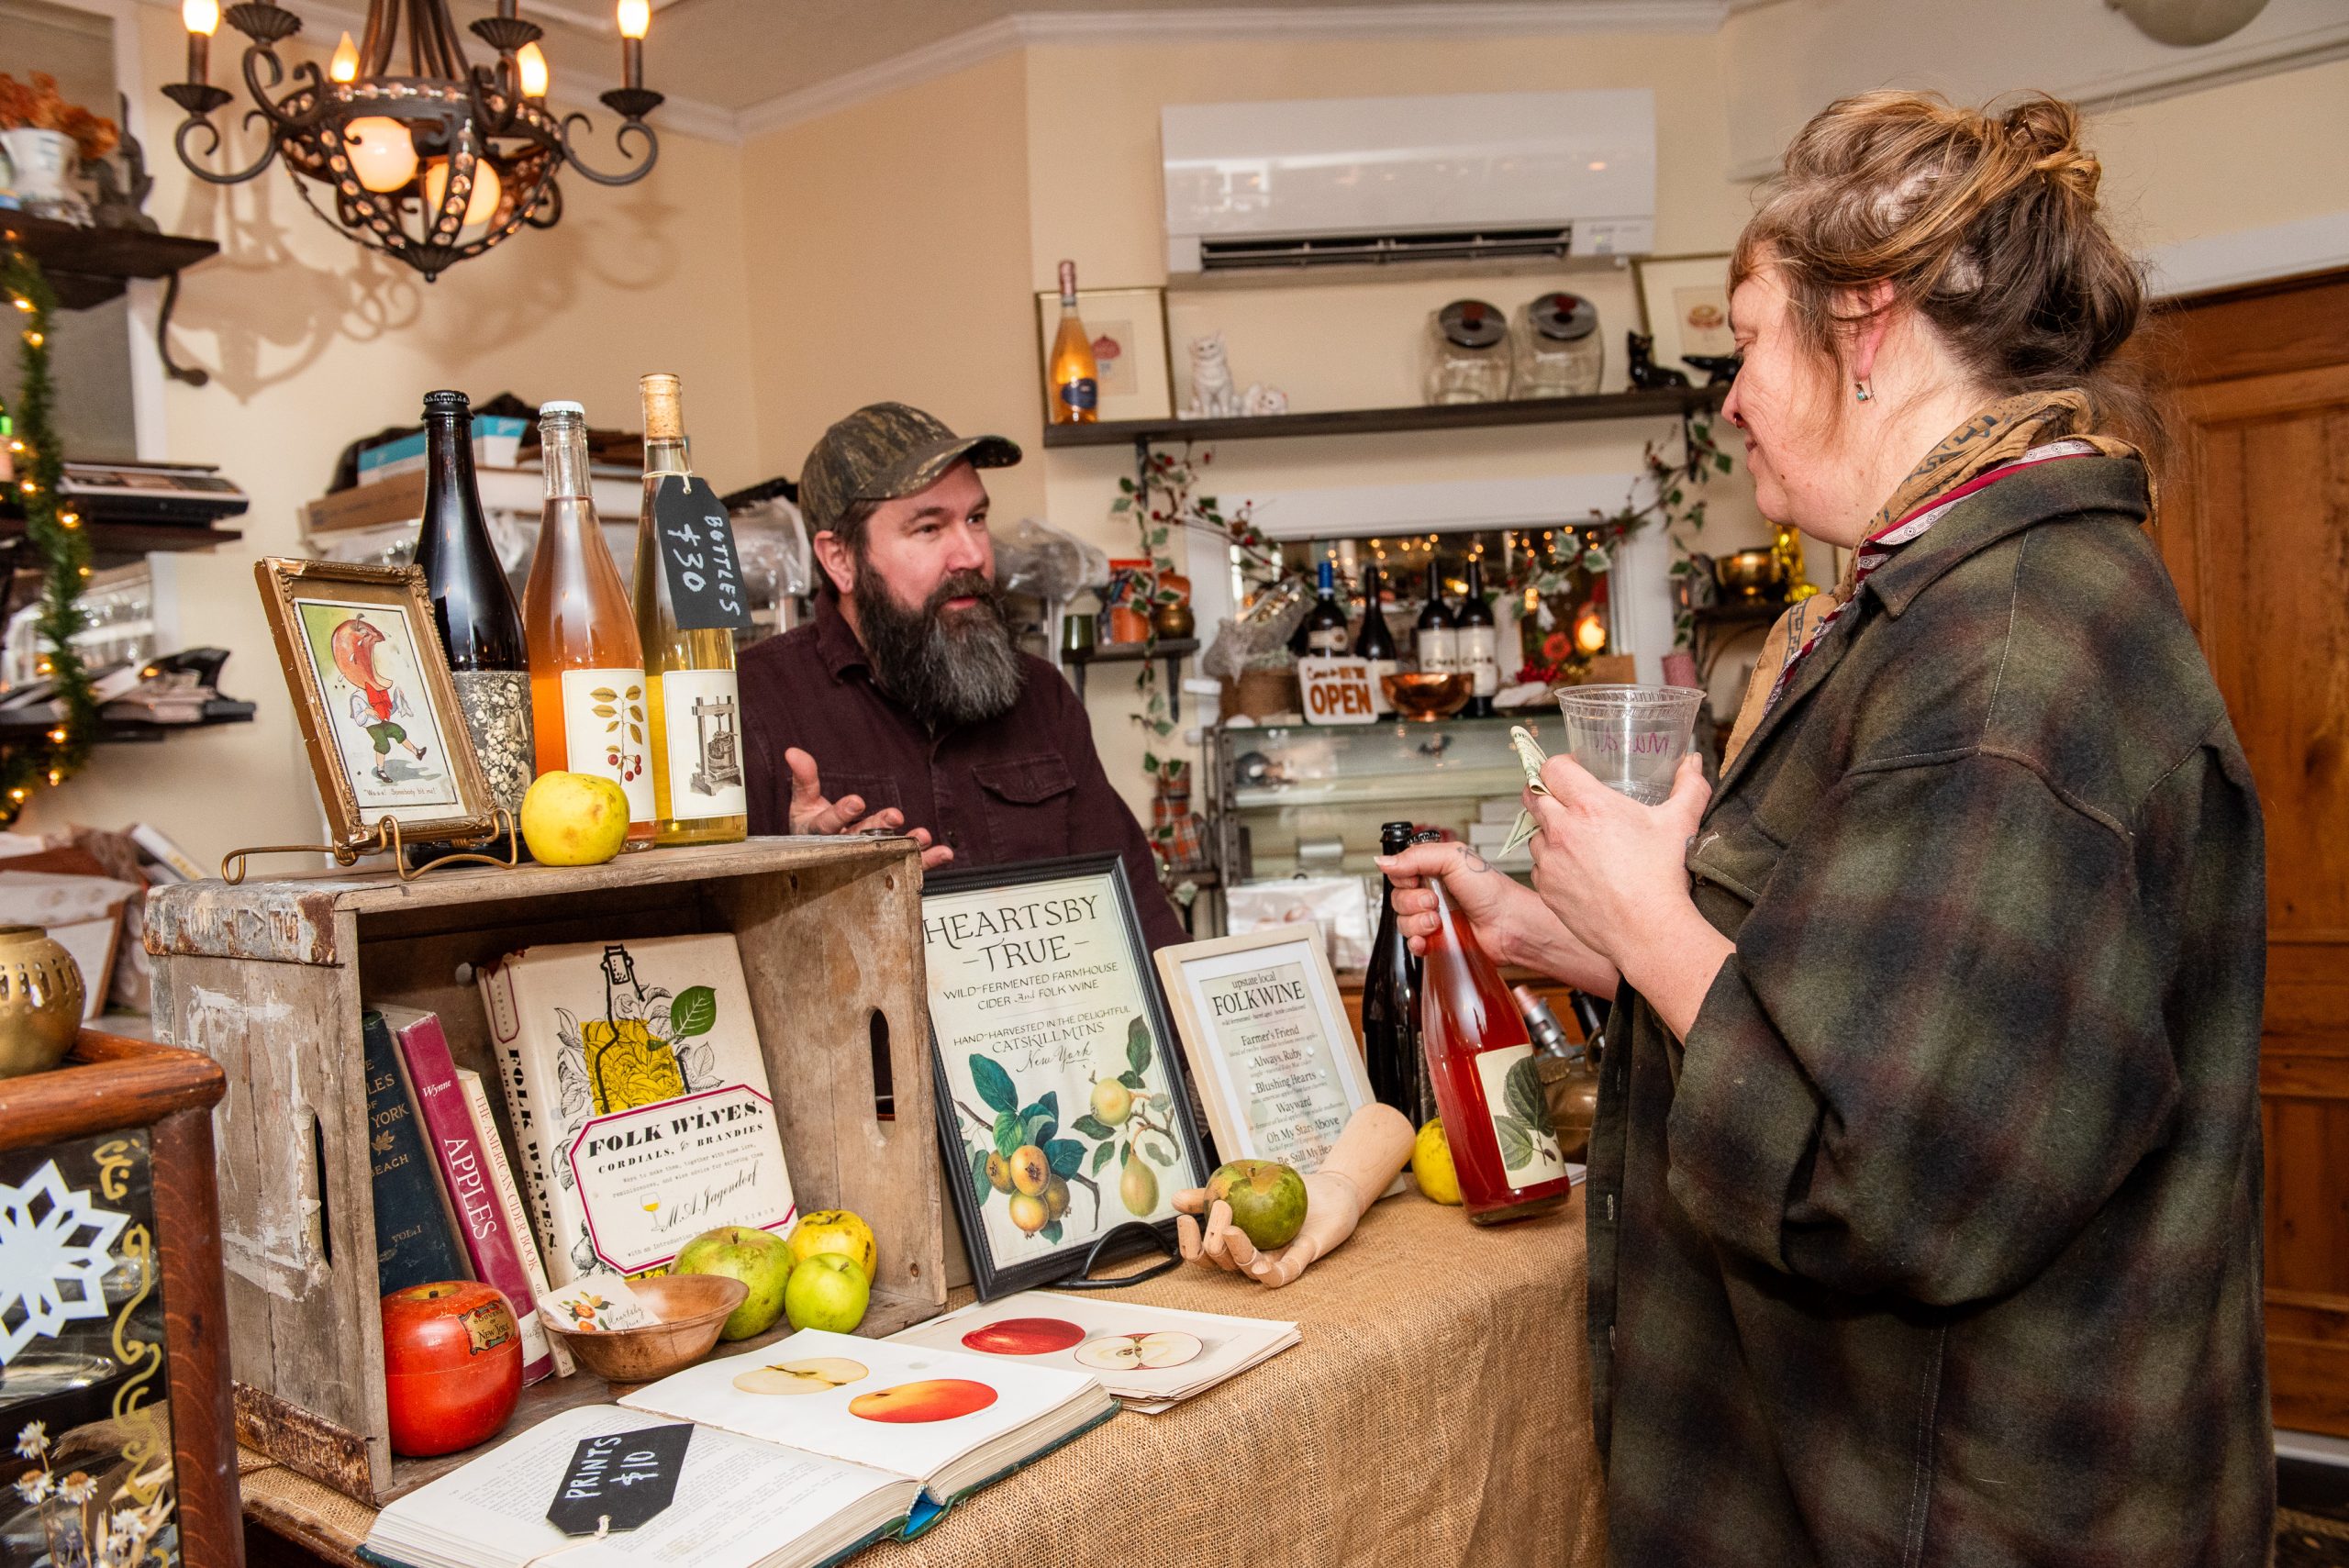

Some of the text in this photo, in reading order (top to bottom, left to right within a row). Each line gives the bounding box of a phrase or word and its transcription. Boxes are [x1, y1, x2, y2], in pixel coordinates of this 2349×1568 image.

[668, 524, 707, 592] $30
[704, 516, 740, 616] BOTTLES
[1310, 684, 1373, 716] OPEN
[923, 895, 1097, 950] HEARTSBY
[978, 935, 1071, 973] TRUE
[943, 962, 1119, 1000] WILD-FERMENTED FARMHOUSE
[977, 995, 1011, 1011] CIDER
[1039, 986, 1067, 999] FOLK
[1070, 979, 1099, 993] WINE
[1231, 971, 1277, 991] upstate local
[953, 1006, 1130, 1046] HAND-HARVESTED IN THE DELIGHTFUL
[992, 1021, 1105, 1054] CATSKILL MTNS
[1241, 1030, 1275, 1047] Farmer's
[1275, 1024, 1300, 1040] Friend
[1016, 1040, 1093, 1073] New York
[1283, 1048, 1302, 1062] Ruby
[366, 1073, 395, 1095] LES
[422, 1079, 451, 1098] Wynne
[507, 1047, 534, 1130] FOLK
[1255, 1076, 1292, 1094] Blushing
[1291, 1071, 1317, 1085] Hearts
[371, 1103, 409, 1129] YORK
[1275, 1095, 1312, 1114] Wayward
[586, 1124, 663, 1159] FOLK
[680, 1140, 690, 1151] &
[697, 1123, 764, 1147] BRANDIES
[1266, 1131, 1281, 1145] Oh
[1281, 1128, 1295, 1140] My
[1295, 1123, 1314, 1137] Stars
[1315, 1117, 1341, 1131] Above
[684, 1155, 709, 1166] together
[711, 1151, 724, 1160] with
[1290, 1149, 1308, 1163] Still
[1307, 1147, 1320, 1160] My
[1319, 1144, 1332, 1156] Hea
[444, 1138, 497, 1240] APPLES
[475, 1092, 540, 1272] THE AMERICAN CIDER BOOK
[628, 1248, 642, 1257] with
[653, 1231, 696, 1250] Introduction
[564, 1437, 622, 1498] PRINTS
[608, 1451, 659, 1486] $10
